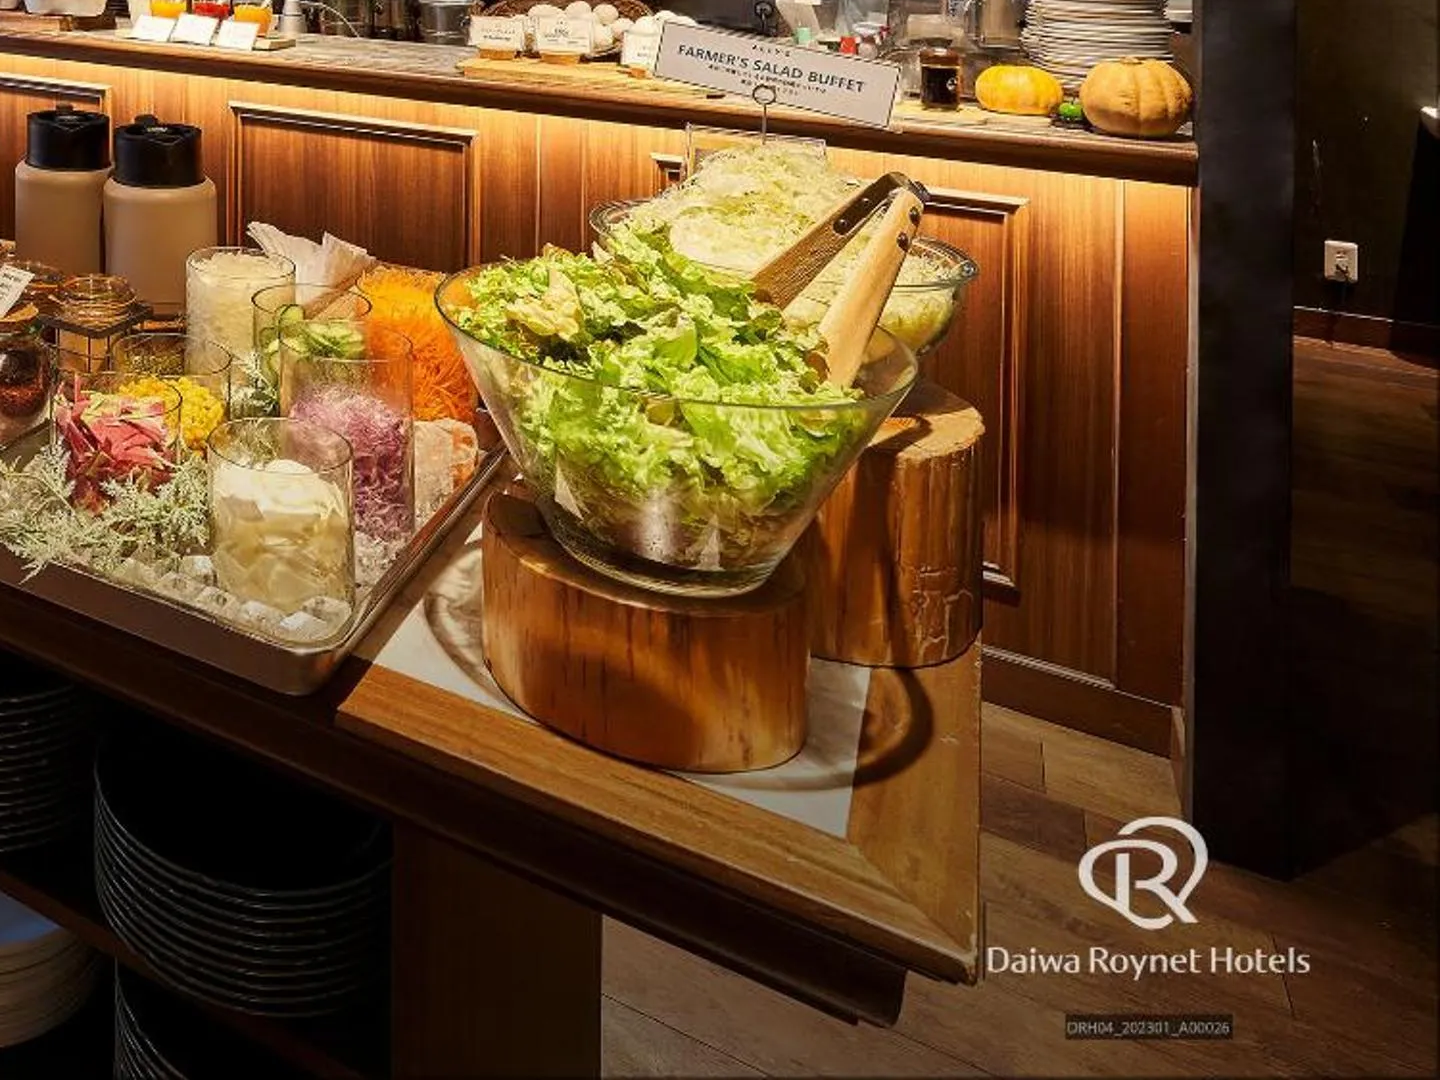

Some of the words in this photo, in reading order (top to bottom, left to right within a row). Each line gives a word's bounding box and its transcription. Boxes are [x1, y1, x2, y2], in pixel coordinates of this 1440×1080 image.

[677, 44, 749, 69] FARMER'S
[753, 60, 803, 80] SALAD
[808, 71, 865, 94] BUFFET
